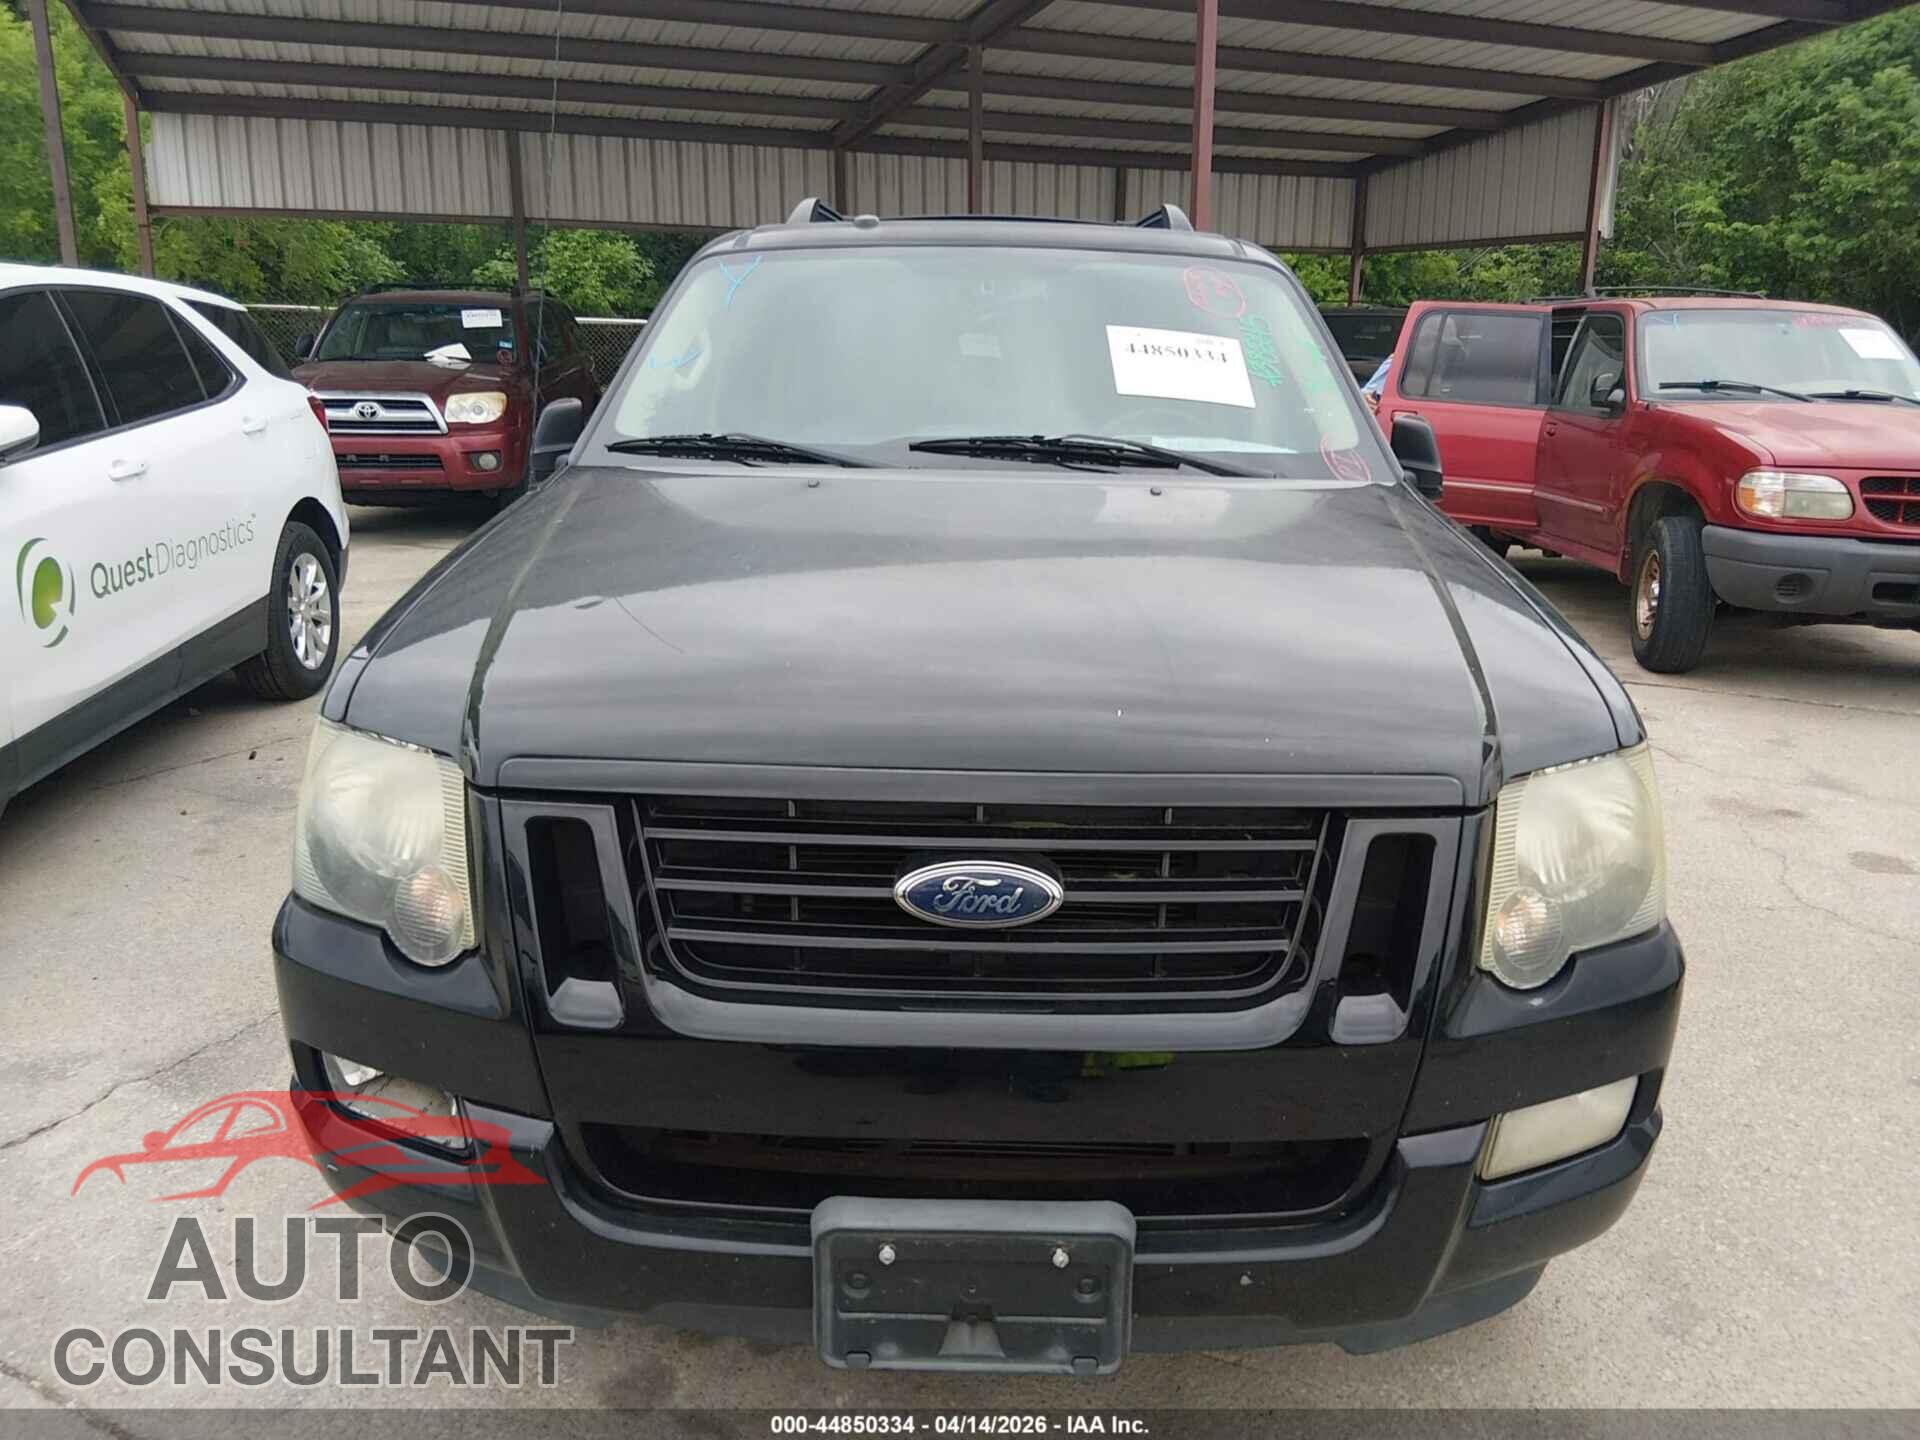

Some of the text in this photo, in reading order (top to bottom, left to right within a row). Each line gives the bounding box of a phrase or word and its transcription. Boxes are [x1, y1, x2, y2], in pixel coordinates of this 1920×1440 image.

[90, 519, 254, 599] Quest Diagnostics
[933, 876, 1024, 913] Ford
